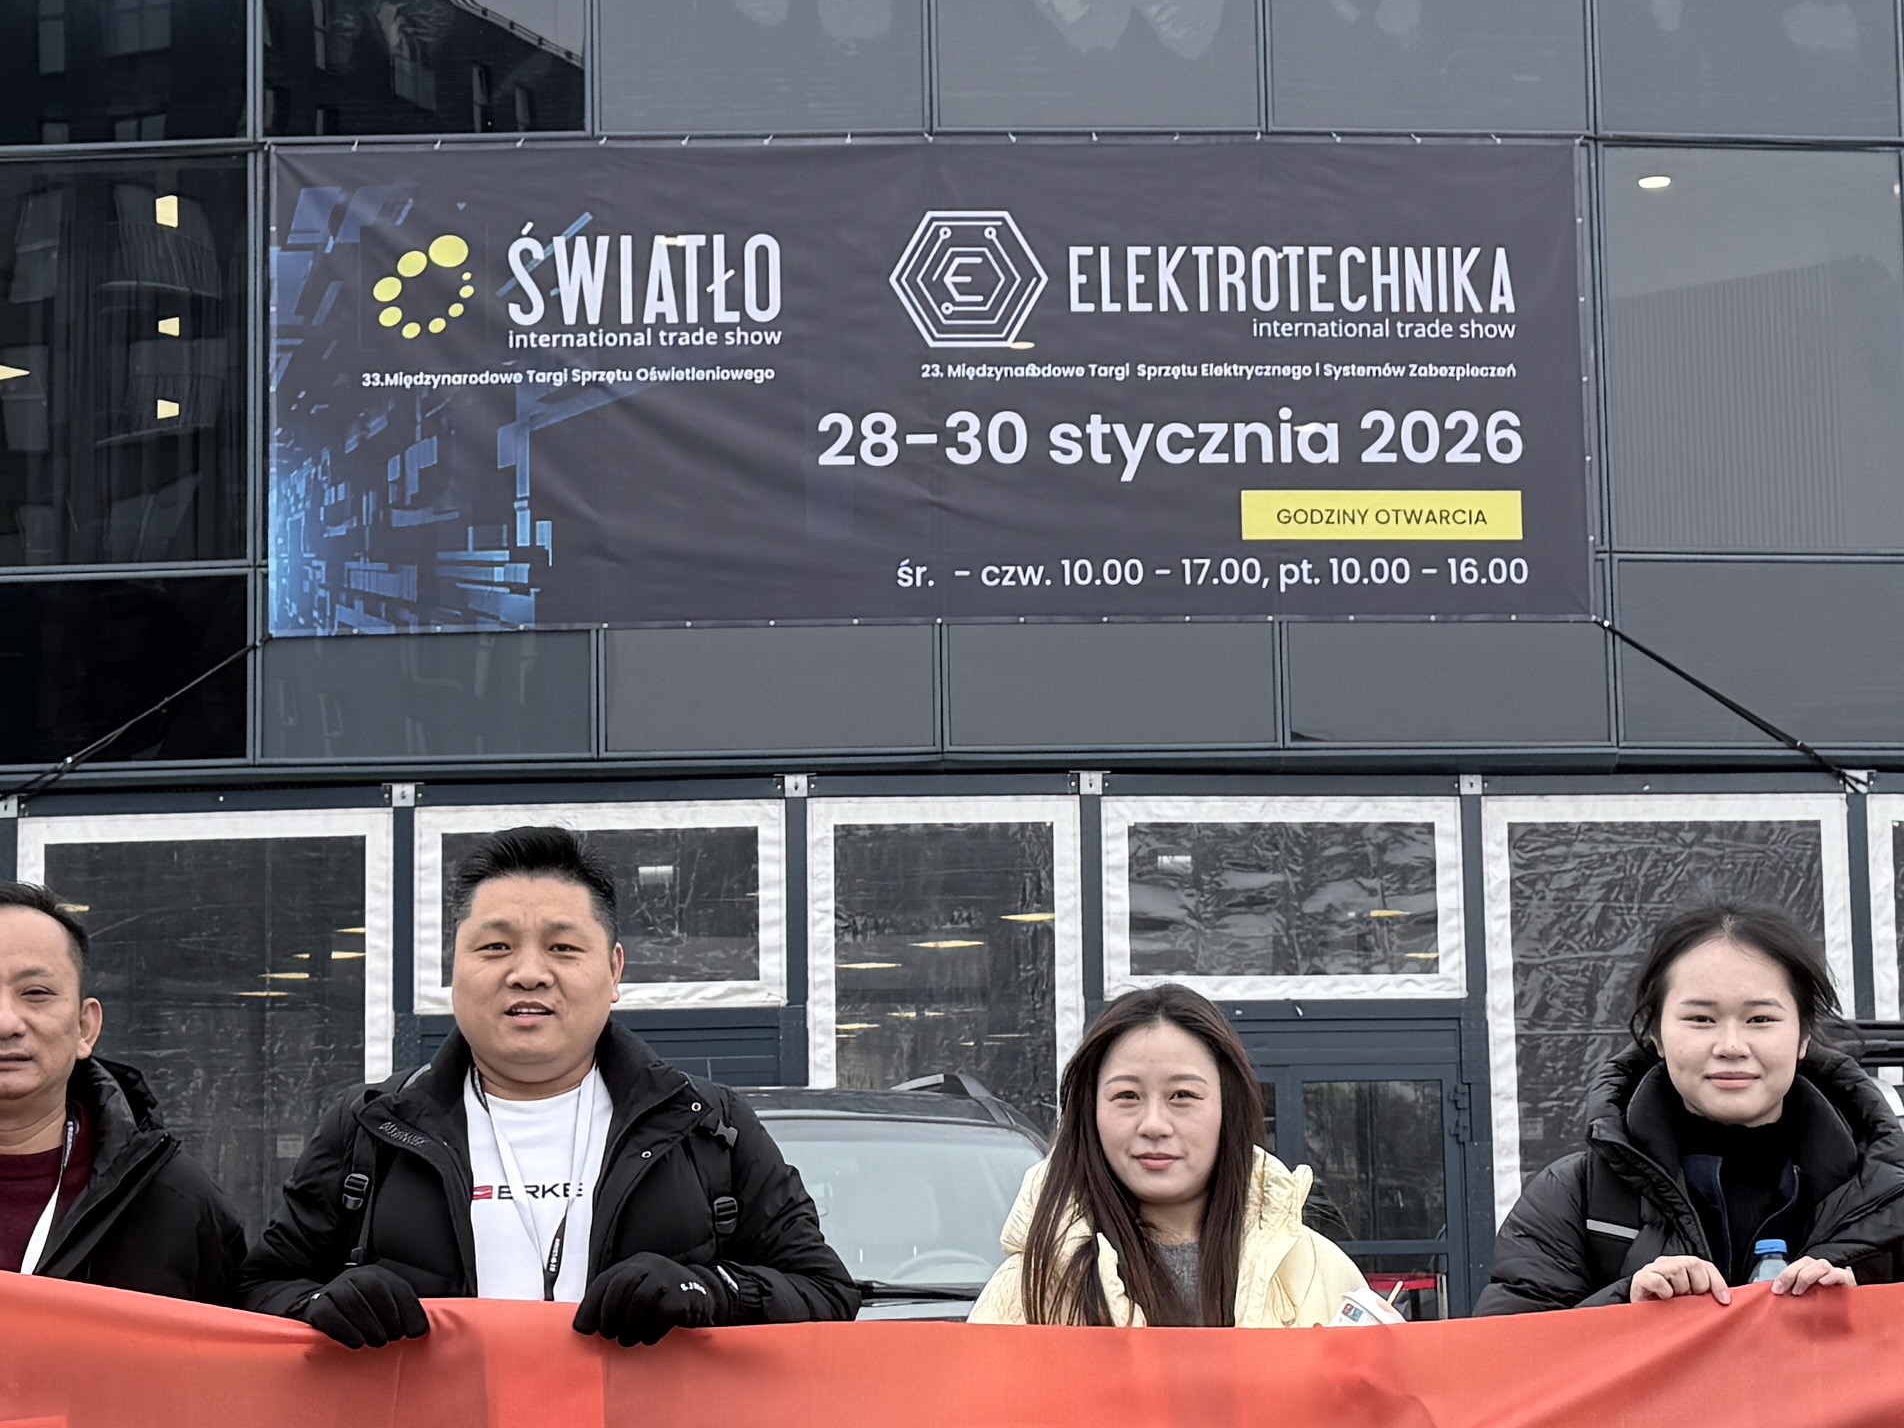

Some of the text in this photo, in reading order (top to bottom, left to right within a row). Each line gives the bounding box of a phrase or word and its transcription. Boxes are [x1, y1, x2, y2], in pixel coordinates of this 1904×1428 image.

[507, 221, 782, 326] ŚWIATŁO
[1068, 245, 1516, 313] ELEKTROTECHNIKA
[508, 326, 782, 349] international trade show
[1253, 318, 1516, 338] international trade show
[526, 368, 568, 387] Targi
[921, 364, 944, 378] 23.
[1088, 362, 1130, 381] Targi
[816, 407, 1524, 482] 28-30 stycznia 2026
[1276, 508, 1488, 525] GODZINY OTWARCIA
[896, 558, 935, 588] śr.
[981, 564, 1052, 587] czw.
[1061, 557, 1144, 586] 10.00
[1181, 557, 1270, 589] 17.00,
[1279, 558, 1321, 592] pt.
[1329, 557, 1411, 585] 10.00
[1447, 557, 1529, 585] 16.00
